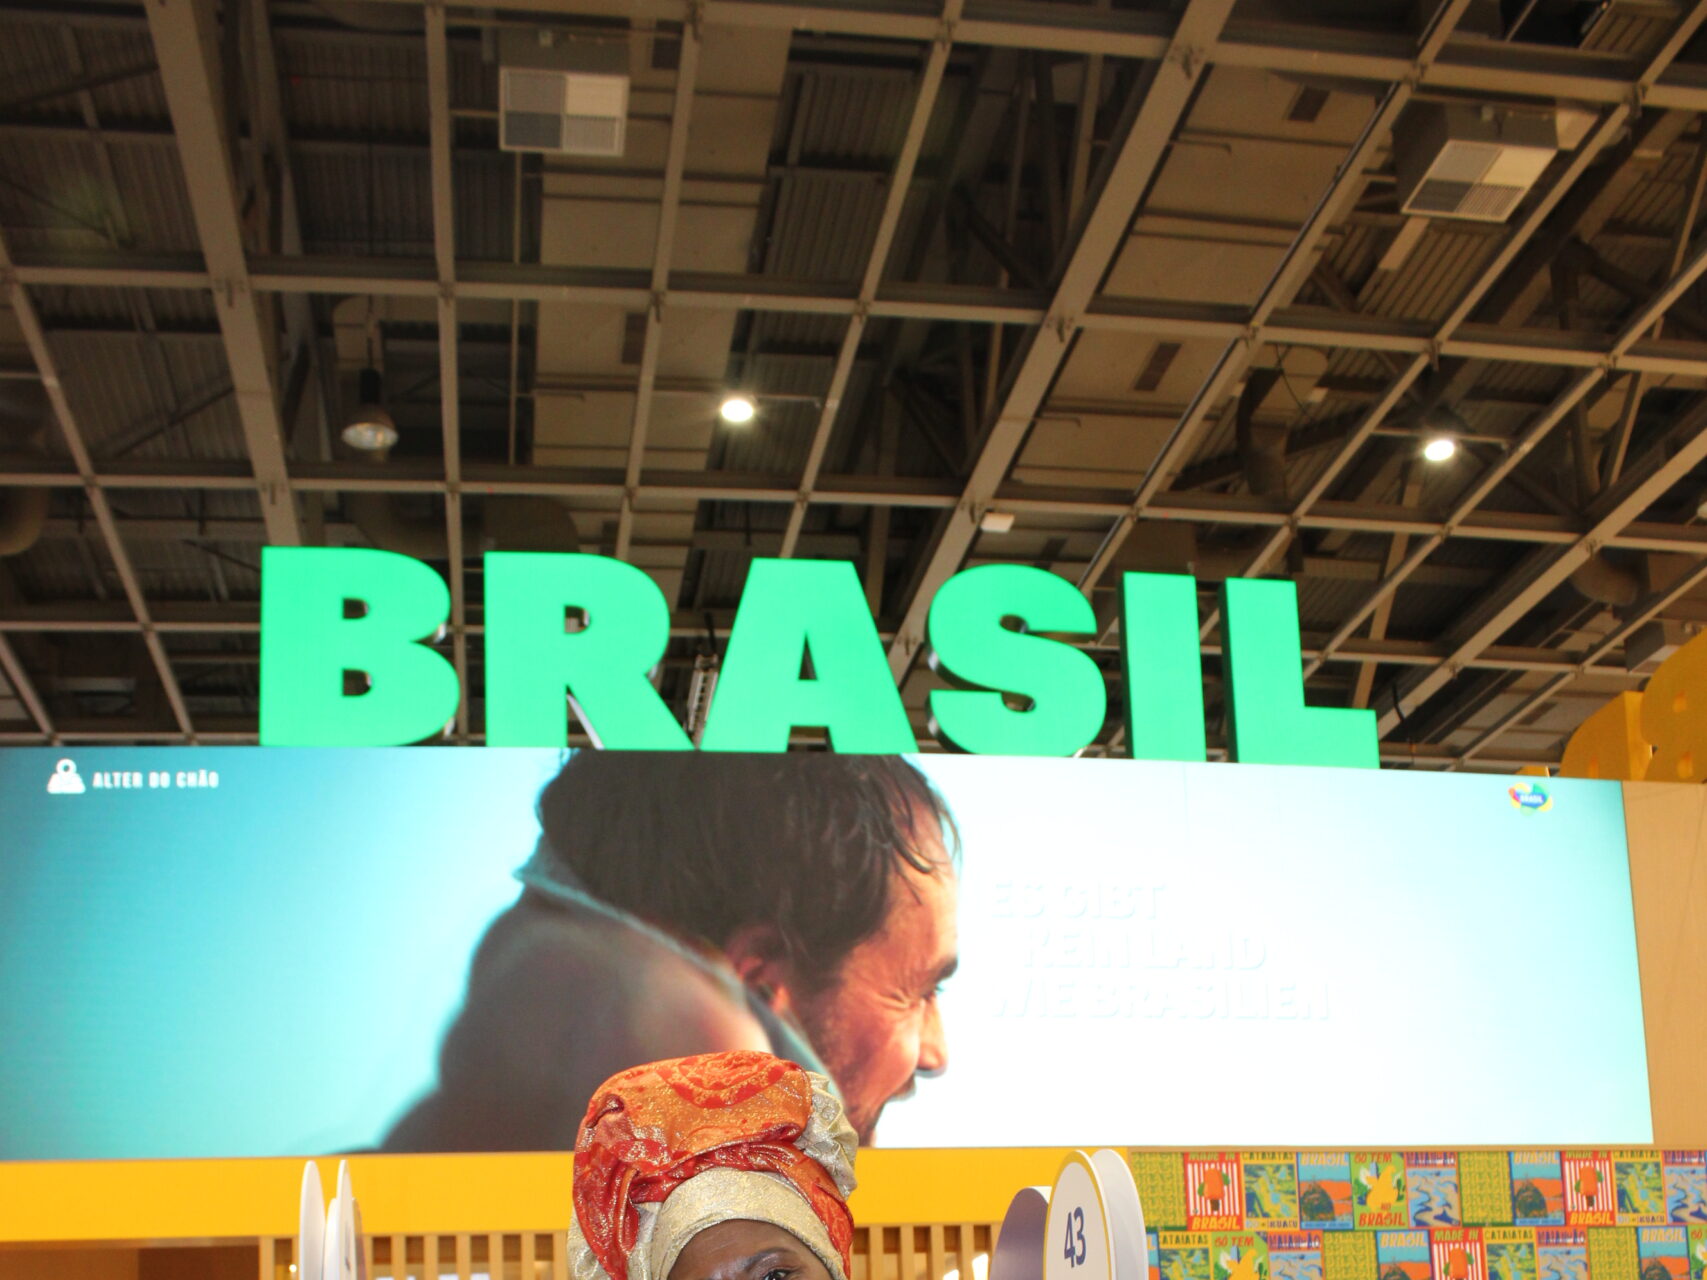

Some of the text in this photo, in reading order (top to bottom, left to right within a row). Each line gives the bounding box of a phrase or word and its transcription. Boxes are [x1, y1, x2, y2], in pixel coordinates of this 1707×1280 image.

[260, 545, 1380, 768] BRASIL
[92, 769, 219, 788] ALTER DO CHÃO
[1192, 1217, 1240, 1229] BRASIL
[1570, 1212, 1613, 1225] BRASIL
[1064, 1206, 1086, 1268] 43
